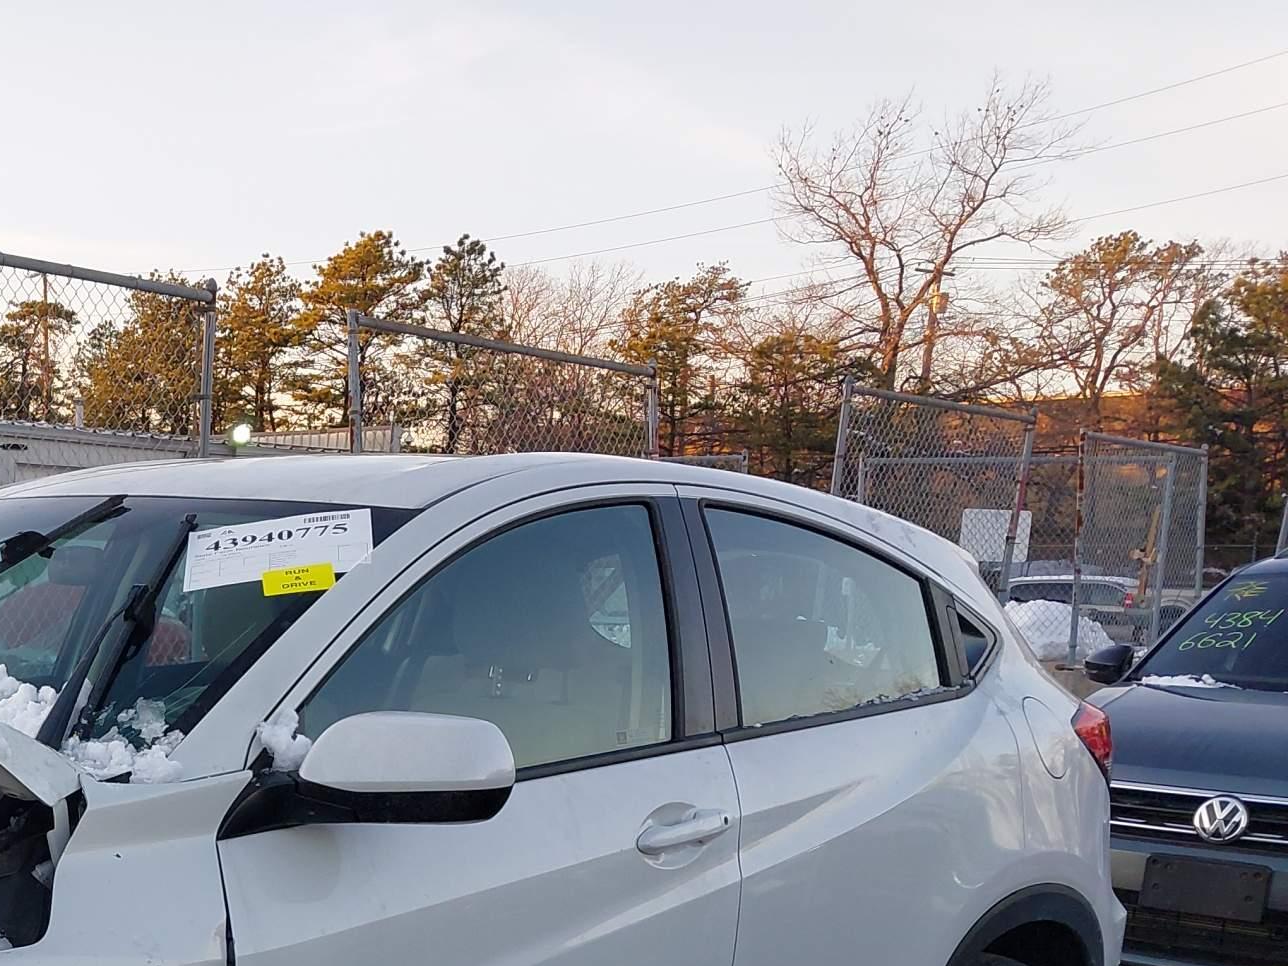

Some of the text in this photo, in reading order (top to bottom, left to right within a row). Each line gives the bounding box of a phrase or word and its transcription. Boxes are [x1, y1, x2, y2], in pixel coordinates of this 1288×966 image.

[205, 523, 348, 551] 43940775
[285, 568, 309, 576] RUN
[281, 580, 317, 589] DRIVE
[1204, 609, 1284, 629] 4384
[1179, 631, 1257, 651] 6621
